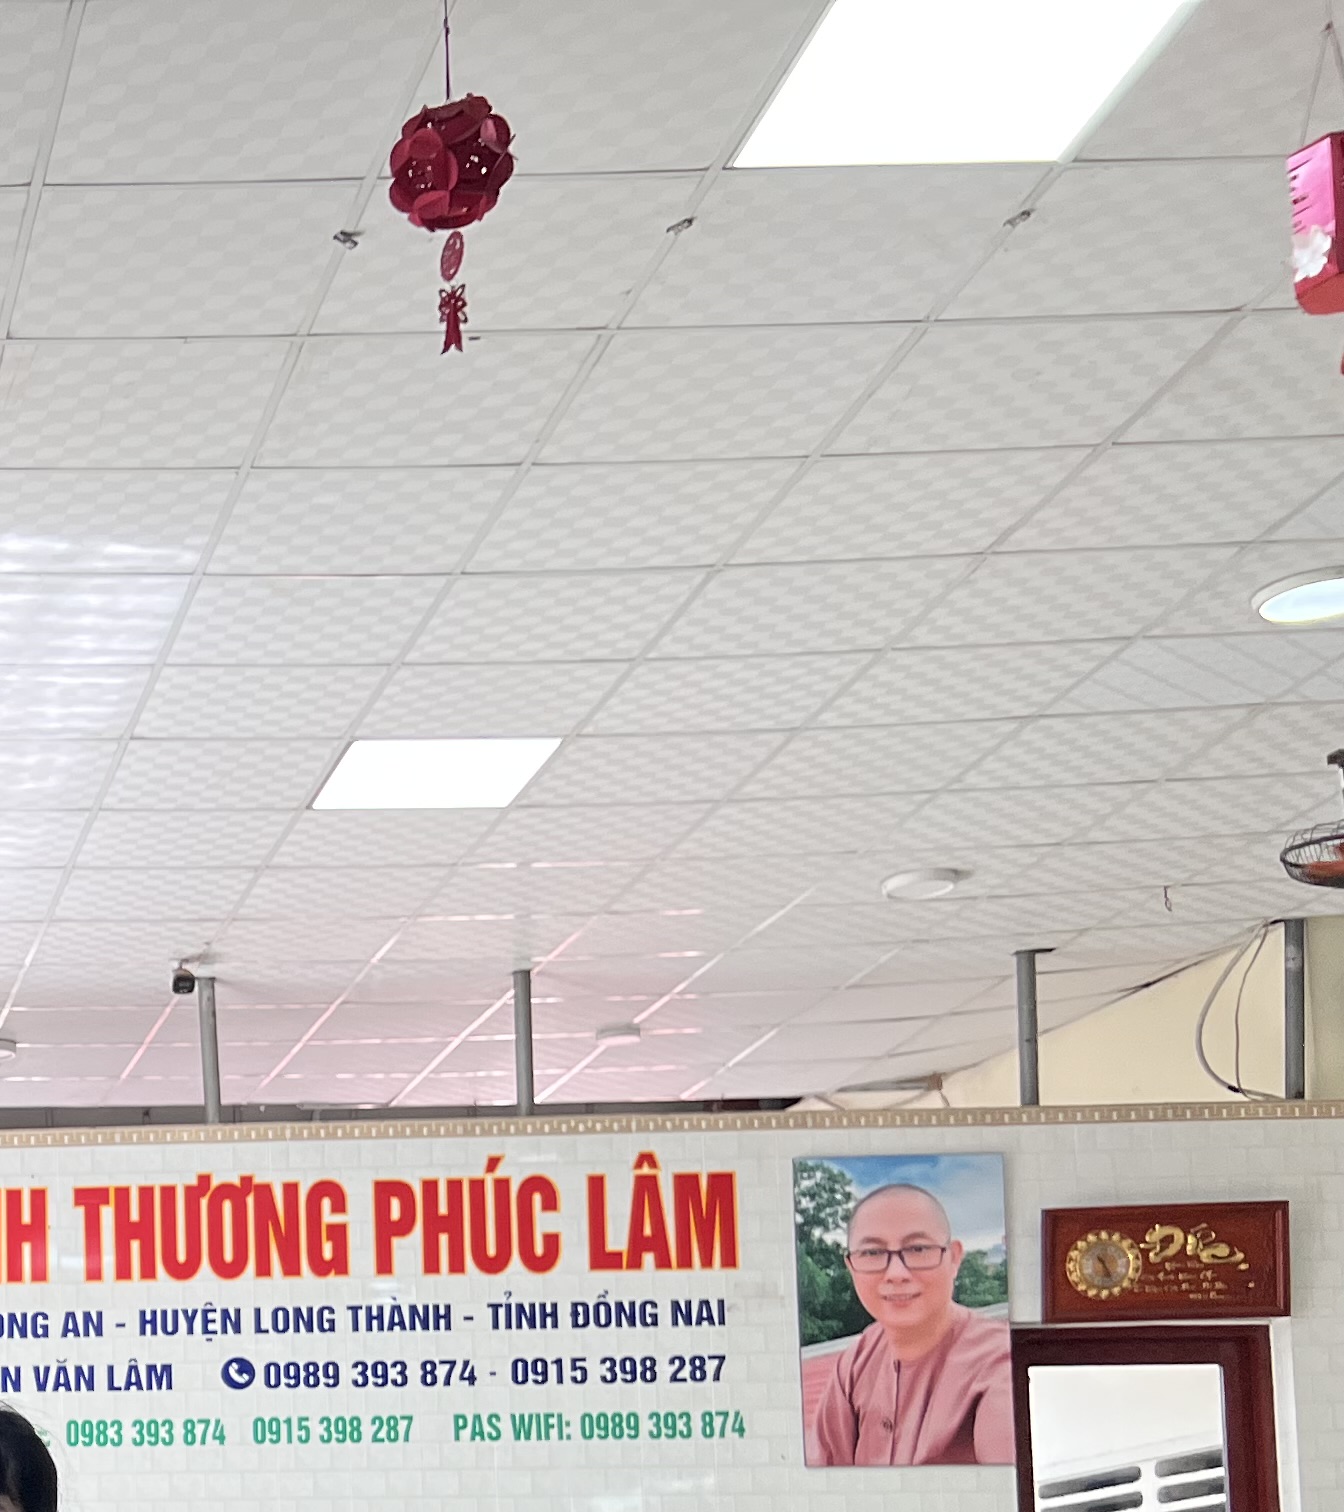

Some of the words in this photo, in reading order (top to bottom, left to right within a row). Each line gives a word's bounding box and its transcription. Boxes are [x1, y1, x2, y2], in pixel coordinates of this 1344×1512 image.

[73, 1172, 350, 1283] THƯƠNG
[372, 1154, 561, 1277] PHÚC
[587, 1151, 739, 1272] LÂM
[60, 1310, 104, 1338] AN
[139, 1301, 242, 1342] HUYỆN
[254, 1305, 336, 1334] LONG
[347, 1296, 452, 1332] THÀNH
[487, 1290, 559, 1330] TỈNH
[571, 1289, 659, 1328] ĐỒNG
[671, 1298, 727, 1326] NAI
[34, 1358, 95, 1392] VĂN
[107, 1358, 174, 1391] LÂM
[264, 1361, 340, 1389] 0989
[351, 1360, 408, 1387] 393
[420, 1359, 477, 1386] 874
[511, 1356, 588, 1385] 0915
[600, 1355, 658, 1384] 398
[669, 1354, 726, 1382] 287
[66, 1419, 123, 1447] 0983
[132, 1418, 174, 1446] 393
[183, 1418, 226, 1445] 874
[253, 1416, 310, 1444] 0915
[319, 1415, 362, 1443] 398
[371, 1415, 414, 1443] 287
[453, 1412, 502, 1441] PAS
[511, 1412, 572, 1441] WIFI:
[581, 1412, 640, 1440] 0989
[648, 1411, 692, 1439] 393
[701, 1410, 746, 1438] 874
